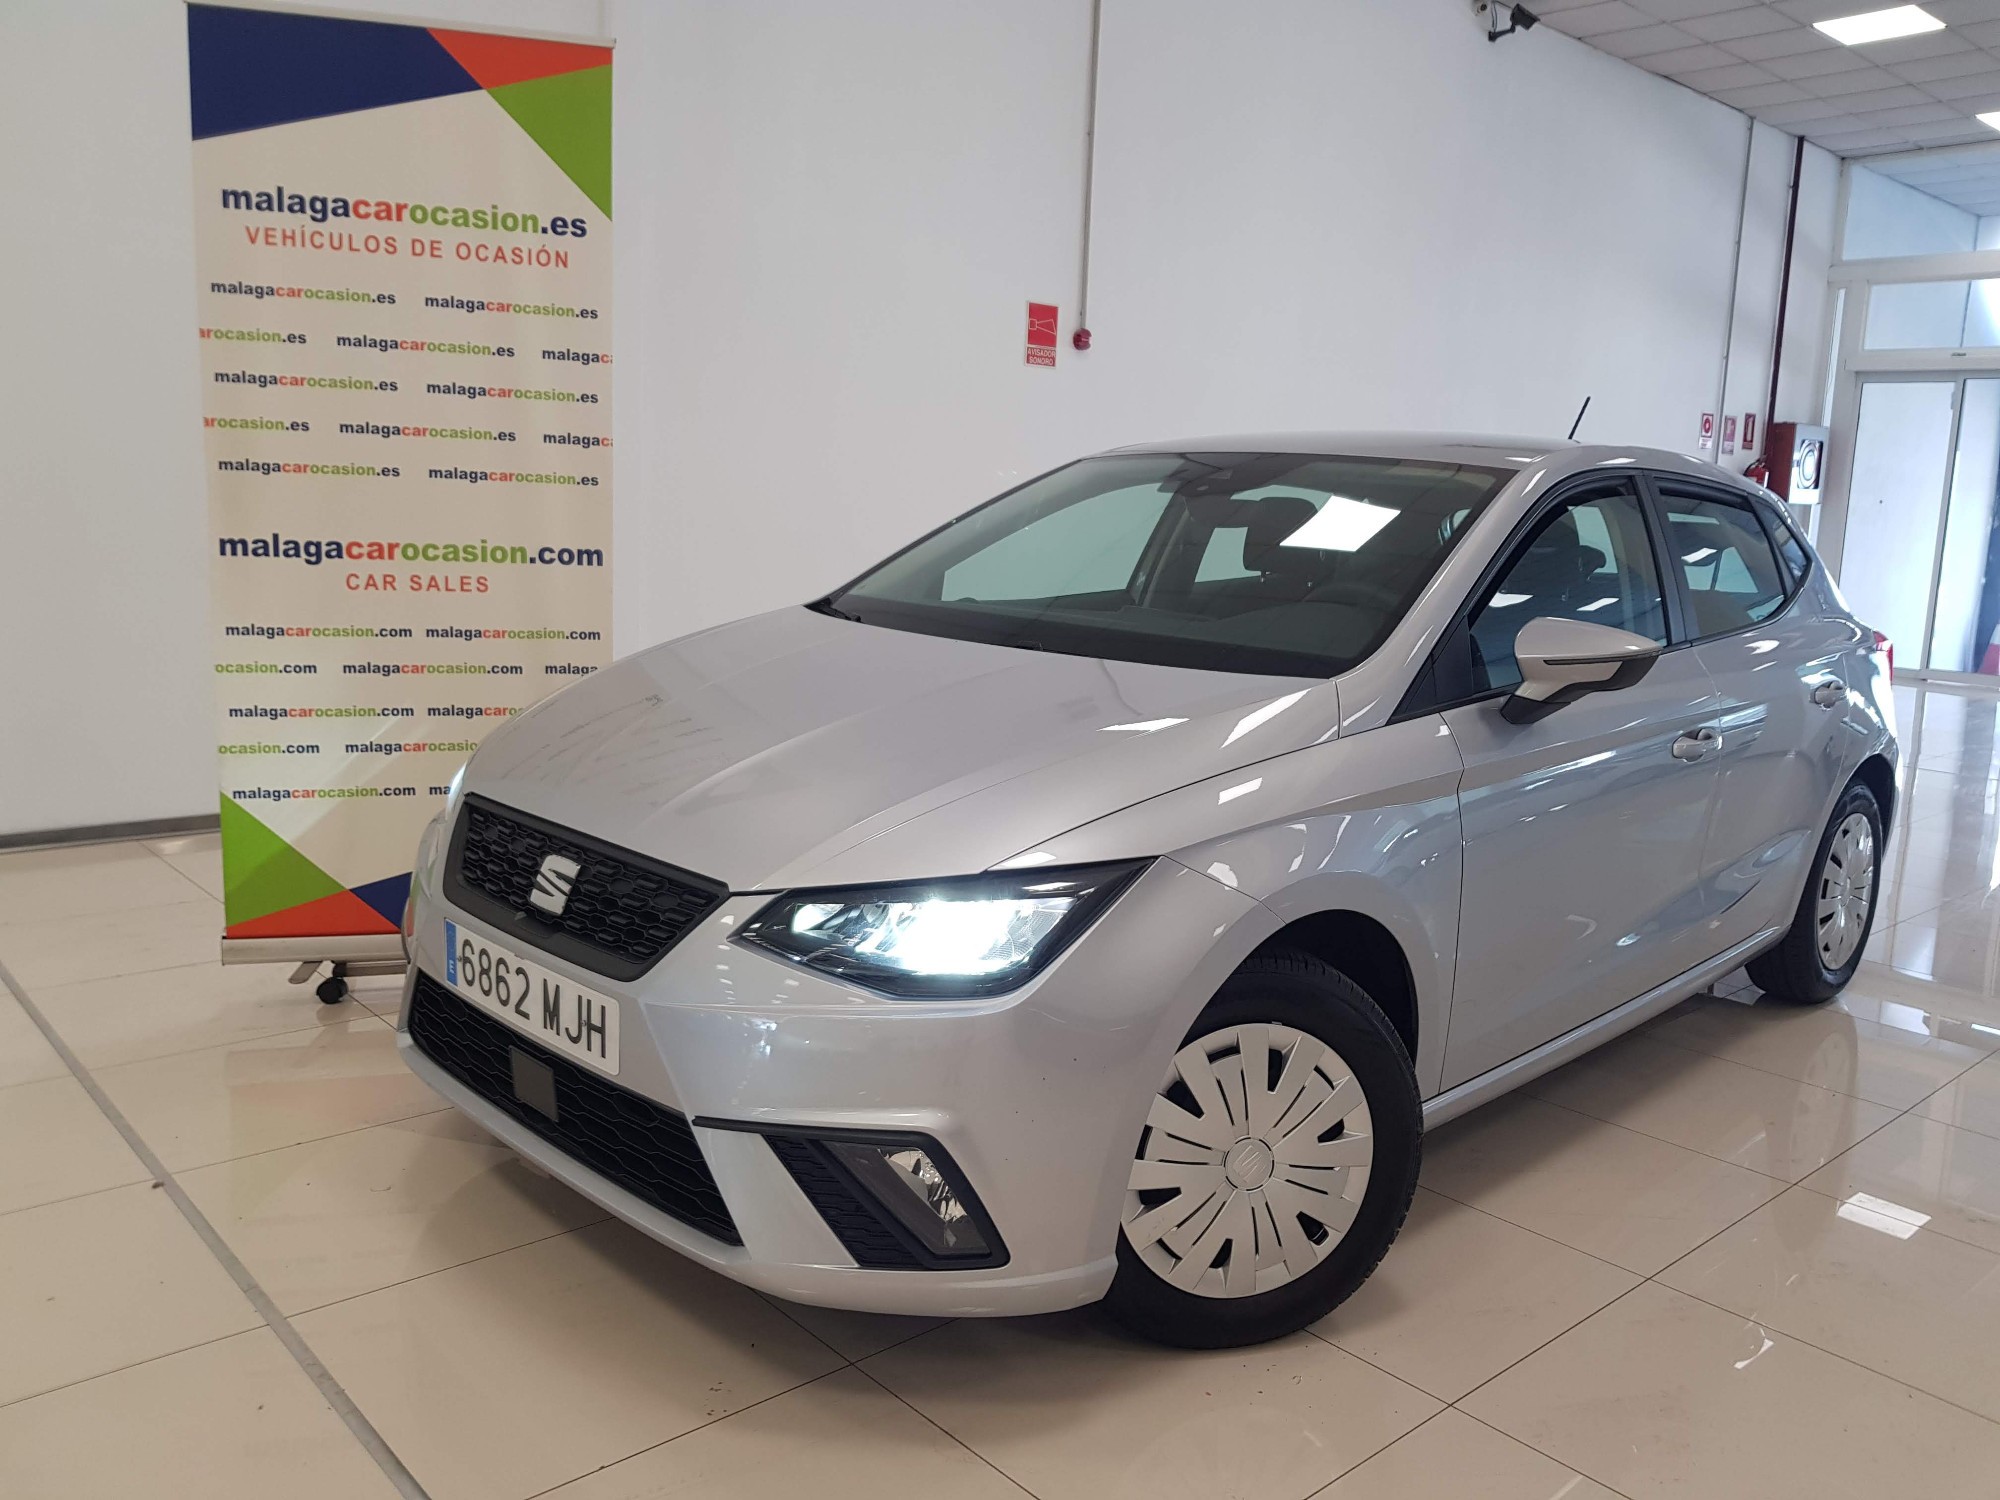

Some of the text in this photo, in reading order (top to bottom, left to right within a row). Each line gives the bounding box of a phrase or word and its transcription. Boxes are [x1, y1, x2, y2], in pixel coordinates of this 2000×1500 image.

[222, 186, 588, 238] malagacarocasion.es
[245, 224, 569, 269] VEHÍCULOS DE OCASIÓN
[211, 281, 396, 305] malagacarocasion.es
[425, 294, 598, 319] malagacarocasion.es
[337, 333, 515, 357] malagacarocasion.es
[542, 348, 613, 365] malagac
[214, 370, 398, 392] malagacarocasion.es
[427, 381, 598, 404] malagacarocasion.es
[339, 420, 516, 442] malagacarocasion.es
[543, 432, 613, 449] malagac
[218, 458, 400, 478] malagacarocasion.es
[429, 466, 599, 486] malagacarocasion.es
[219, 533, 604, 566] malagacarocasion.com
[346, 573, 489, 593] CAR SALES
[225, 623, 412, 639] malagacarocasion.com
[426, 625, 600, 641] malagacarocasion.com
[215, 661, 317, 674] ocasion.com
[343, 662, 523, 677] malagacarocasion.com
[229, 704, 414, 720] malagacarocasion.com
[217, 741, 320, 754] ocasion.com
[232, 786, 416, 802] malagacarocasion.com
[462, 938, 607, 1059] 6862 MJH
